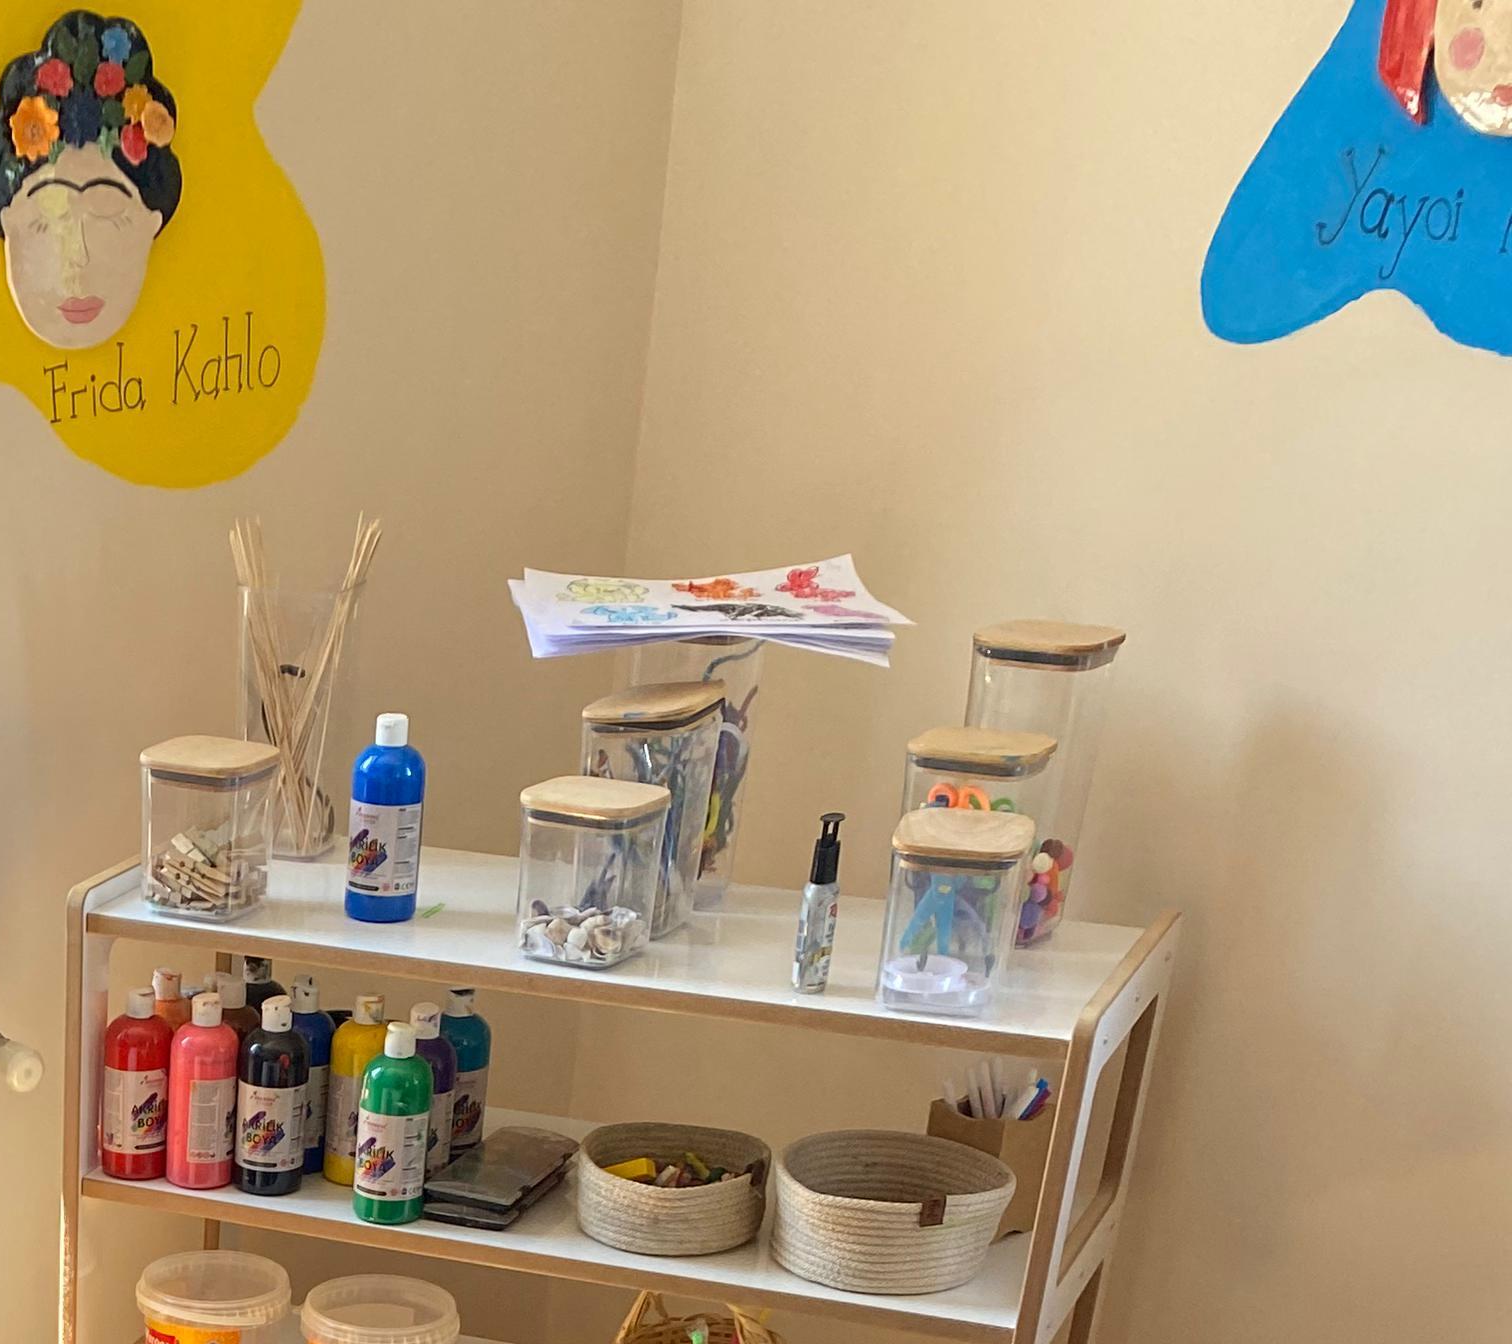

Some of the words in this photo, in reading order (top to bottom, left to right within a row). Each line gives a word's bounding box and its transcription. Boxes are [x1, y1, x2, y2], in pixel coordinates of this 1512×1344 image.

[1316, 144, 1464, 279] Yayoi
[43, 341, 146, 423] Frida
[172, 311, 282, 405] Kahlo
